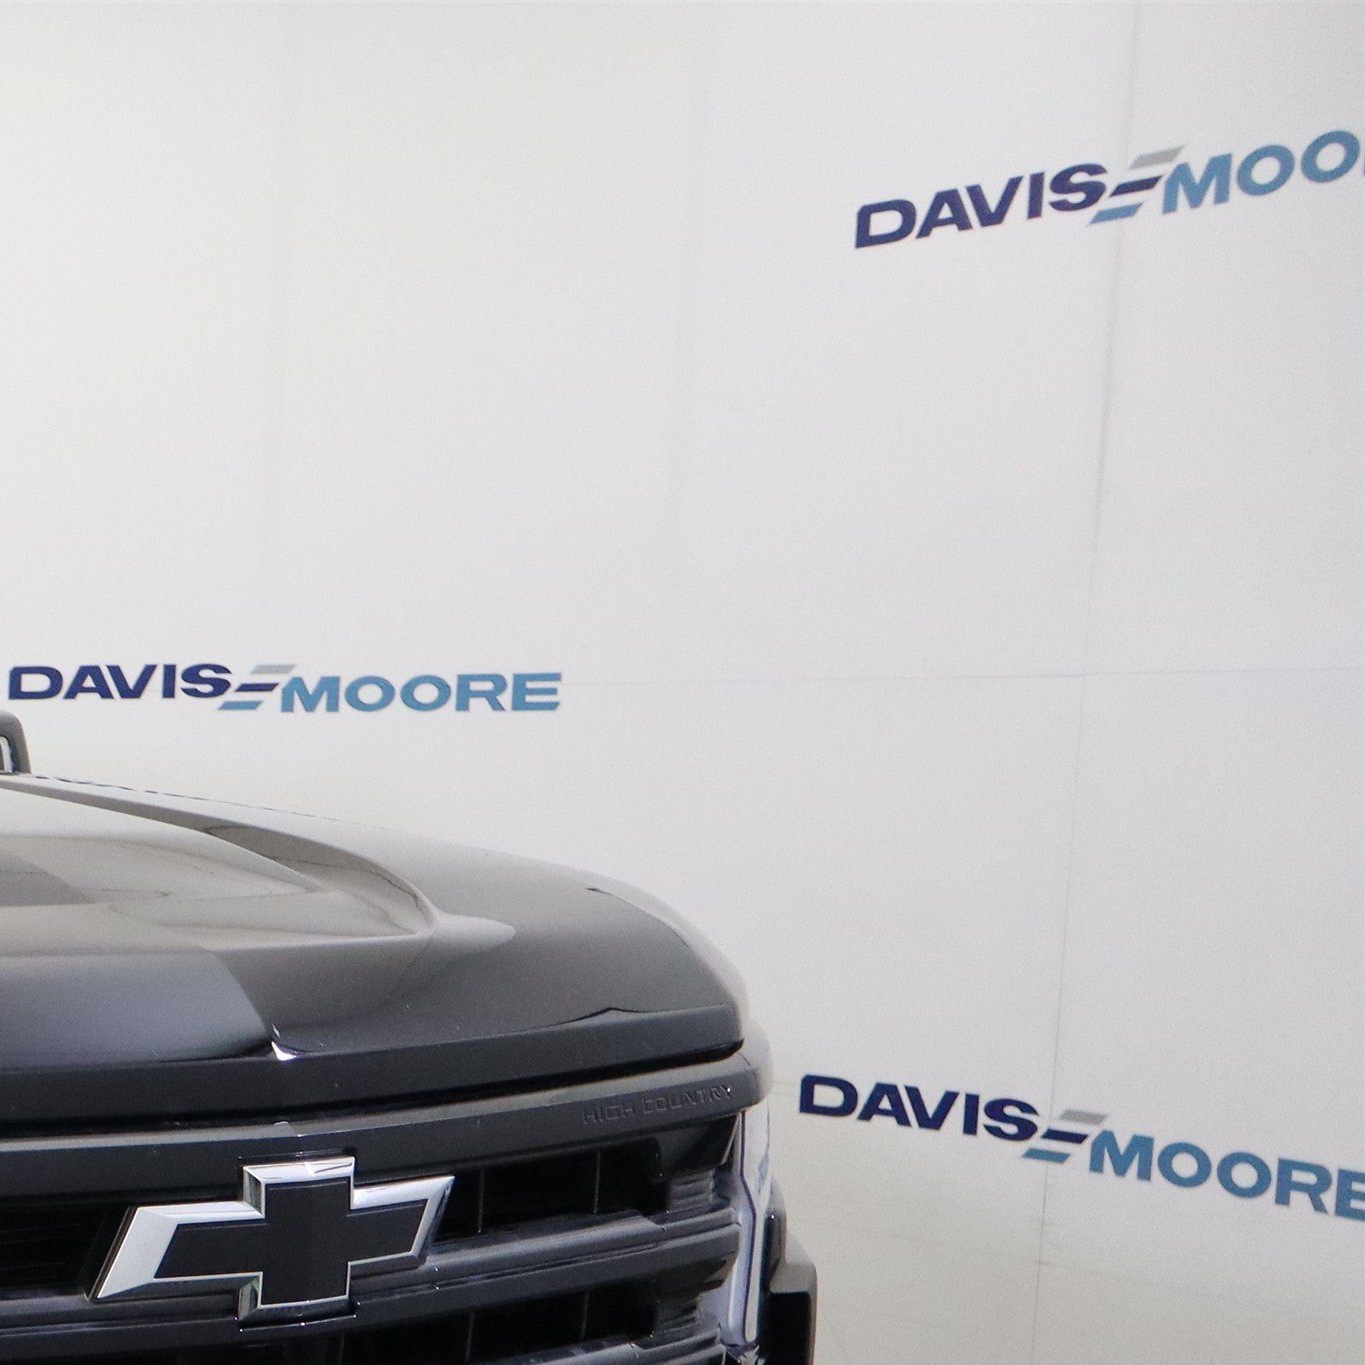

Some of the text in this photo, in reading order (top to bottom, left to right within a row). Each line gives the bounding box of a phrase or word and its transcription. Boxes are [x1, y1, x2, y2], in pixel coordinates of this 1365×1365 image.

[854, 129, 1365, 248] DAVIS MOO
[6, 662, 562, 712] DAVIS MOORE
[582, 1084, 734, 1126] HIGH COUNTRY
[798, 1072, 1038, 1141] DAVIS
